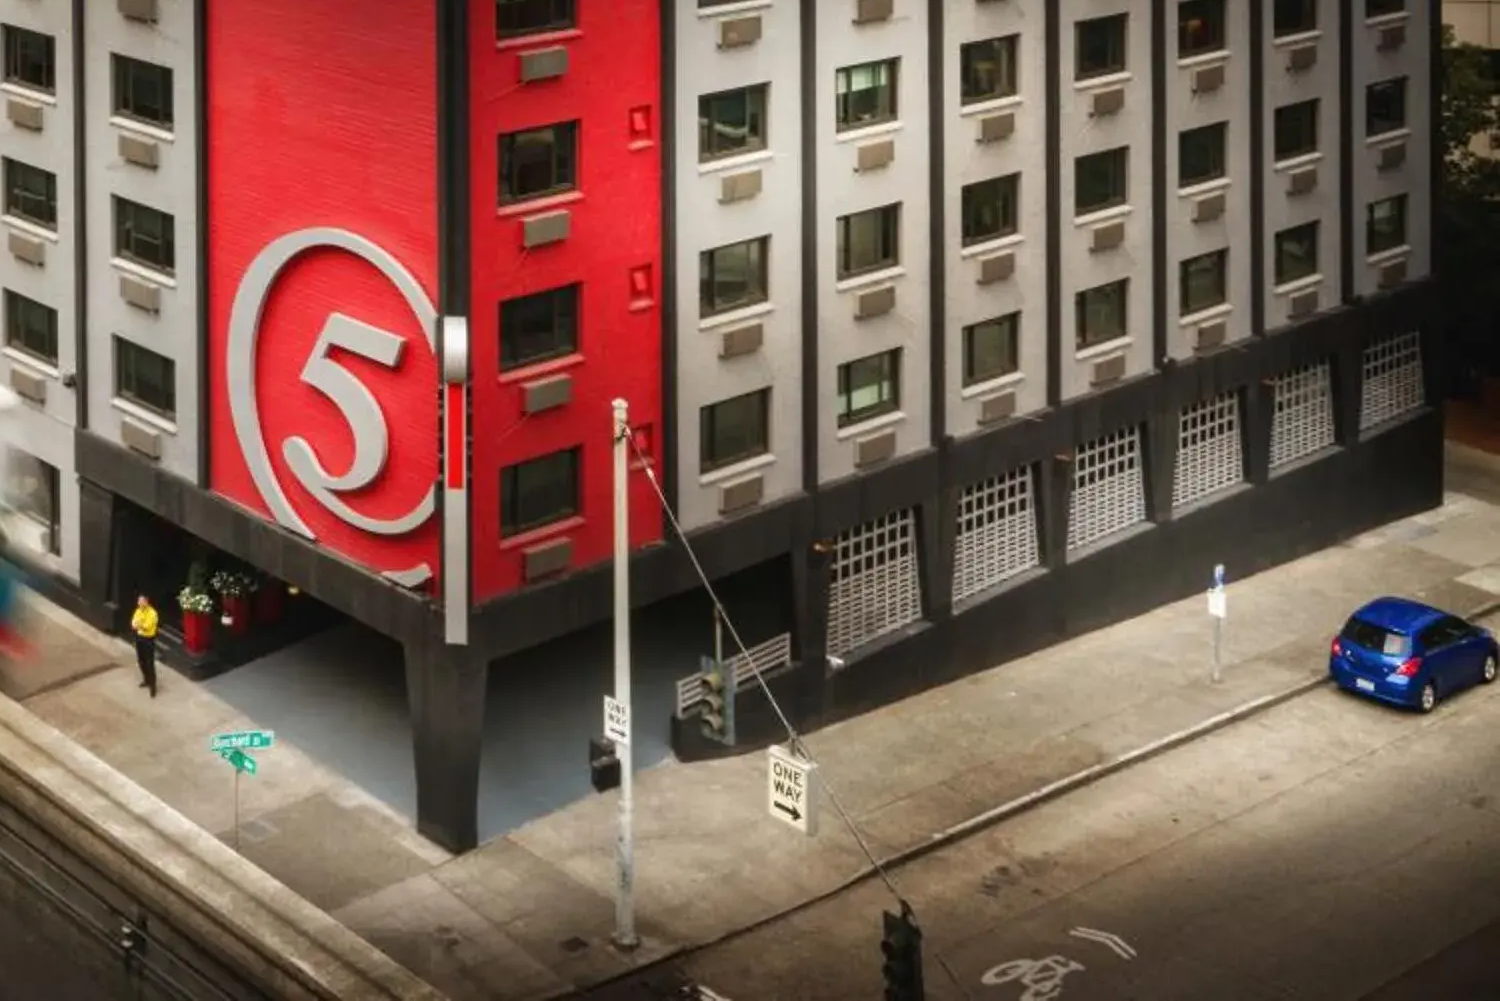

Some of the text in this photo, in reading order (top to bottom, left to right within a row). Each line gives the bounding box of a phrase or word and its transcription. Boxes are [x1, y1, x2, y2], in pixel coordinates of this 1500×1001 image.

[281, 311, 407, 492] 5
[773, 762, 803, 788] ONE
[773, 778, 803, 803] WAY
